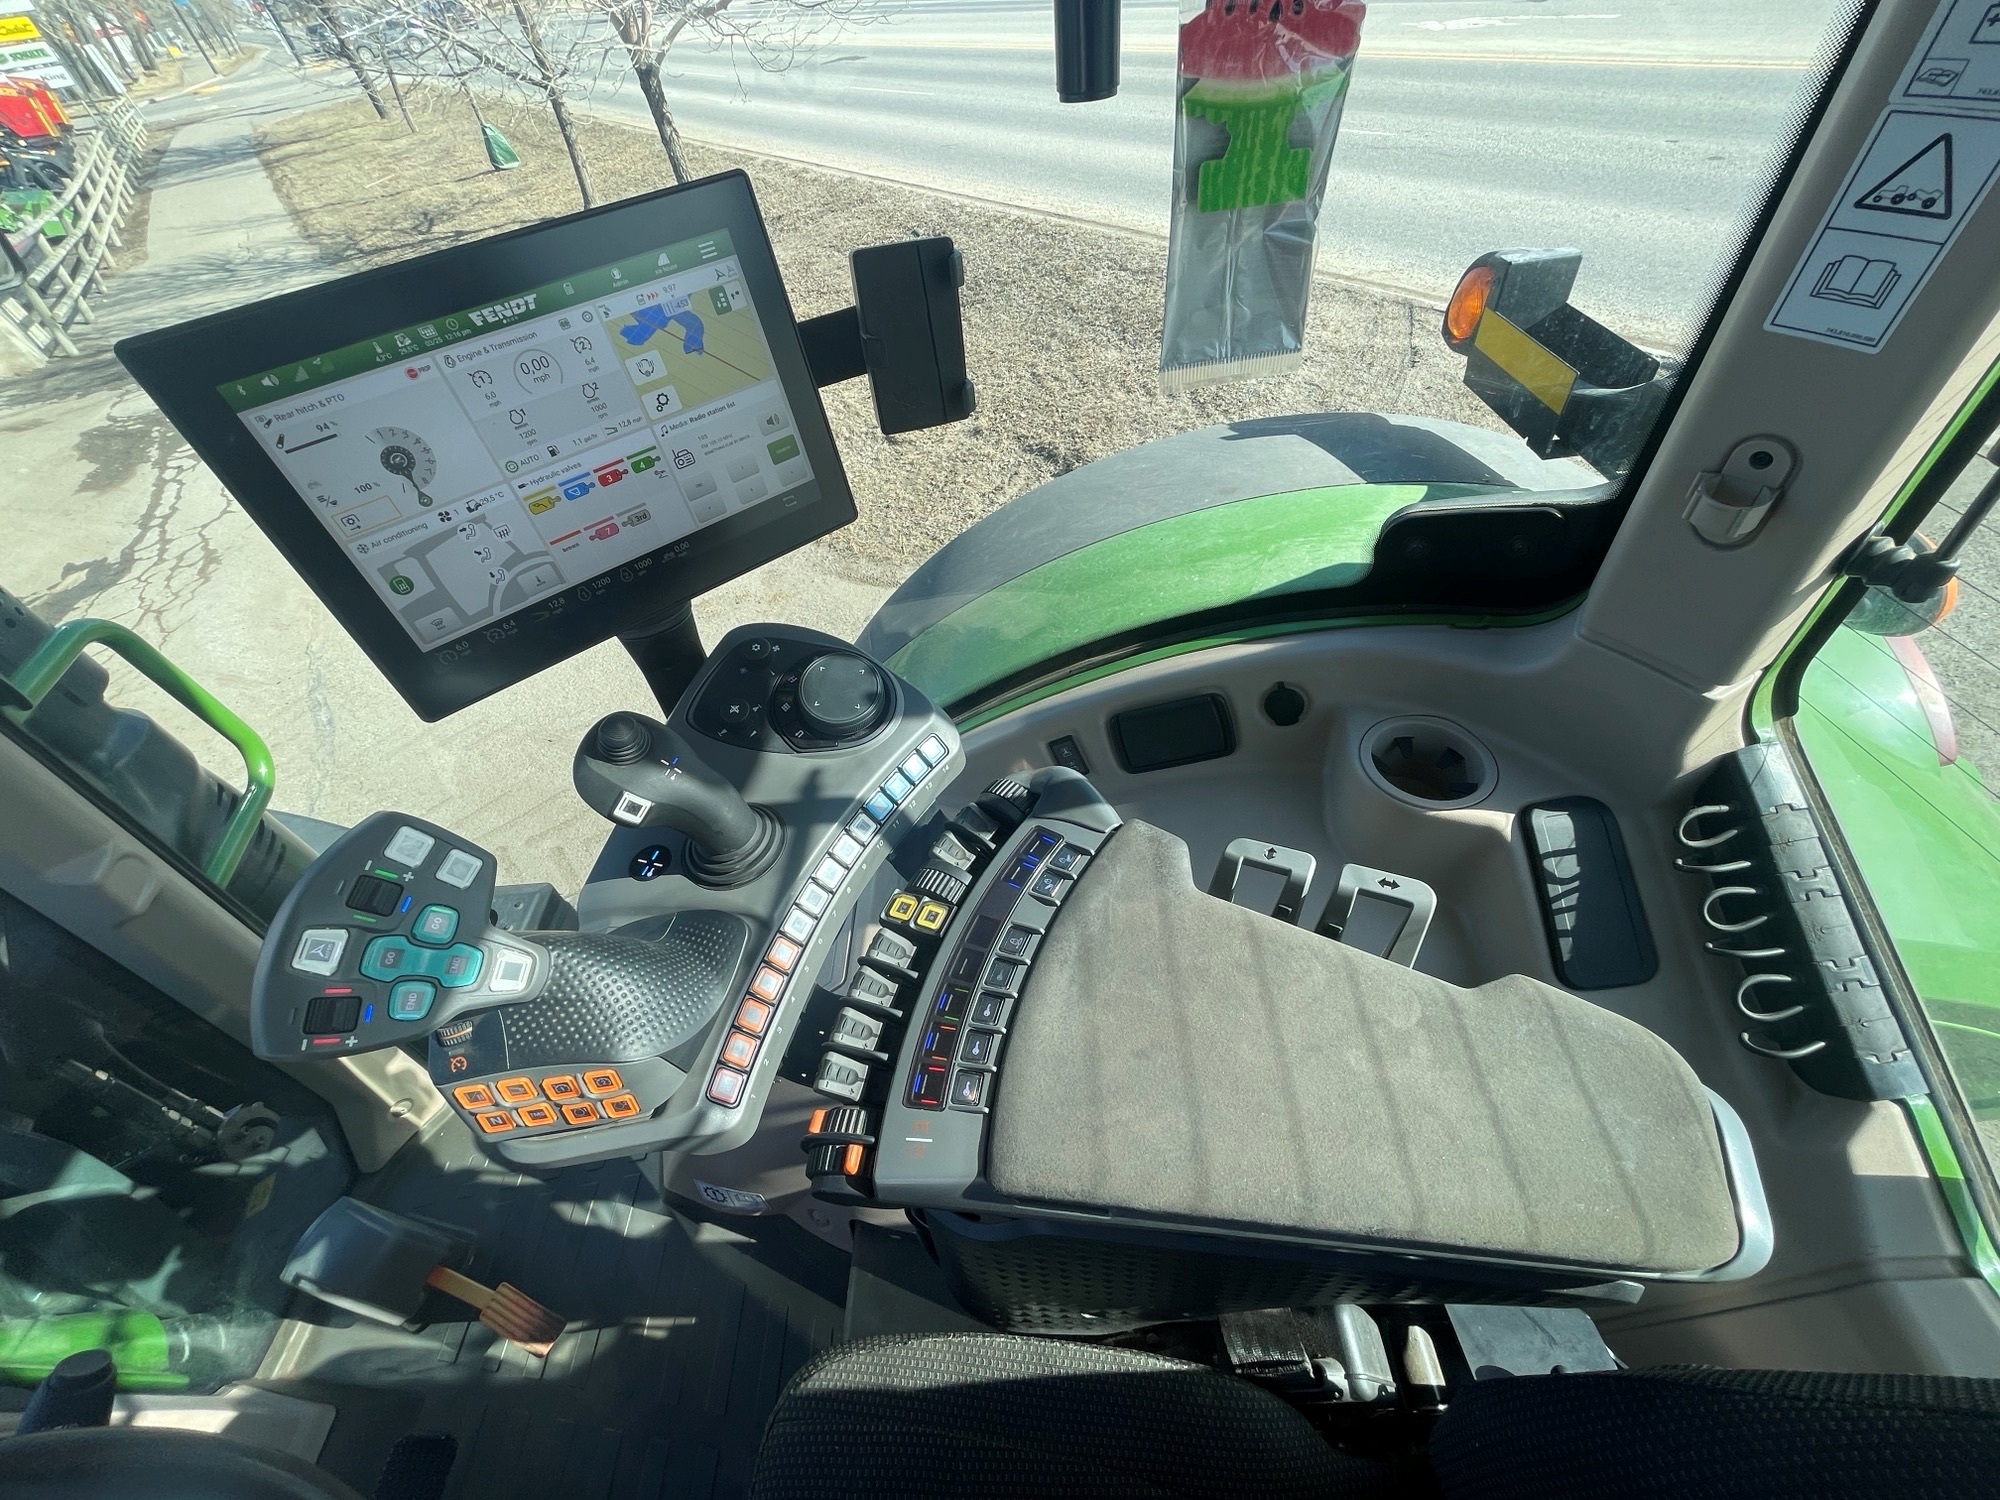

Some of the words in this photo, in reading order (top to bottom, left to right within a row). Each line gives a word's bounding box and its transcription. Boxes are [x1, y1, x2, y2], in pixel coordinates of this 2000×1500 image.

[612, 279, 629, 288] Admin
[468, 293, 537, 327] FENDT
[444, 330, 461, 341] 12:16
[461, 328, 472, 338] pm
[456, 349, 483, 363] Engine
[490, 332, 538, 353] Transmission
[520, 355, 550, 376] 0,00
[584, 357, 596, 367] 6,4
[588, 366, 600, 374] mph
[533, 373, 551, 385] mph
[484, 391, 497, 401] 6,0
[274, 411, 295, 422] Rear
[295, 403, 318, 415] hitch
[326, 393, 345, 405] PTO
[489, 400, 502, 409] mph
[591, 402, 608, 414] 1000
[689, 412, 707, 424] Radio
[706, 405, 727, 418] station
[726, 401, 736, 411] list
[316, 422, 330, 433] 94
[617, 417, 632, 429] 12,8
[389, 428, 397, 437] 2
[518, 429, 537, 440] 1200
[572, 437, 583, 447] 1,1
[520, 453, 540, 467] AUTO
[639, 461, 646, 469] 4
[529, 467, 560, 486] Hydraulic
[560, 462, 582, 475] valves
[606, 474, 613, 483] 3
[354, 482, 373, 494] 100
[479, 495, 496, 506] 29,5
[495, 491, 505, 500] °C
[634, 511, 647, 523] 3rd
[371, 539, 383, 549] Air
[383, 522, 429, 544] conditioning
[634, 557, 653, 571] 1000
[591, 576, 611, 590] 1200
[942, 764, 950, 773] 14
[925, 782, 933, 791] 13
[908, 800, 917, 809] 12
[892, 820, 900, 829] 11
[876, 840, 884, 850] 10
[432, 917, 443, 930] GO
[385, 951, 396, 965] GO
[450, 957, 461, 974] END
[405, 992, 418, 1011] END
[776, 1026, 783, 1034] 3
[763, 1058, 770, 1067] 2
[490, 1116, 503, 1125] N
